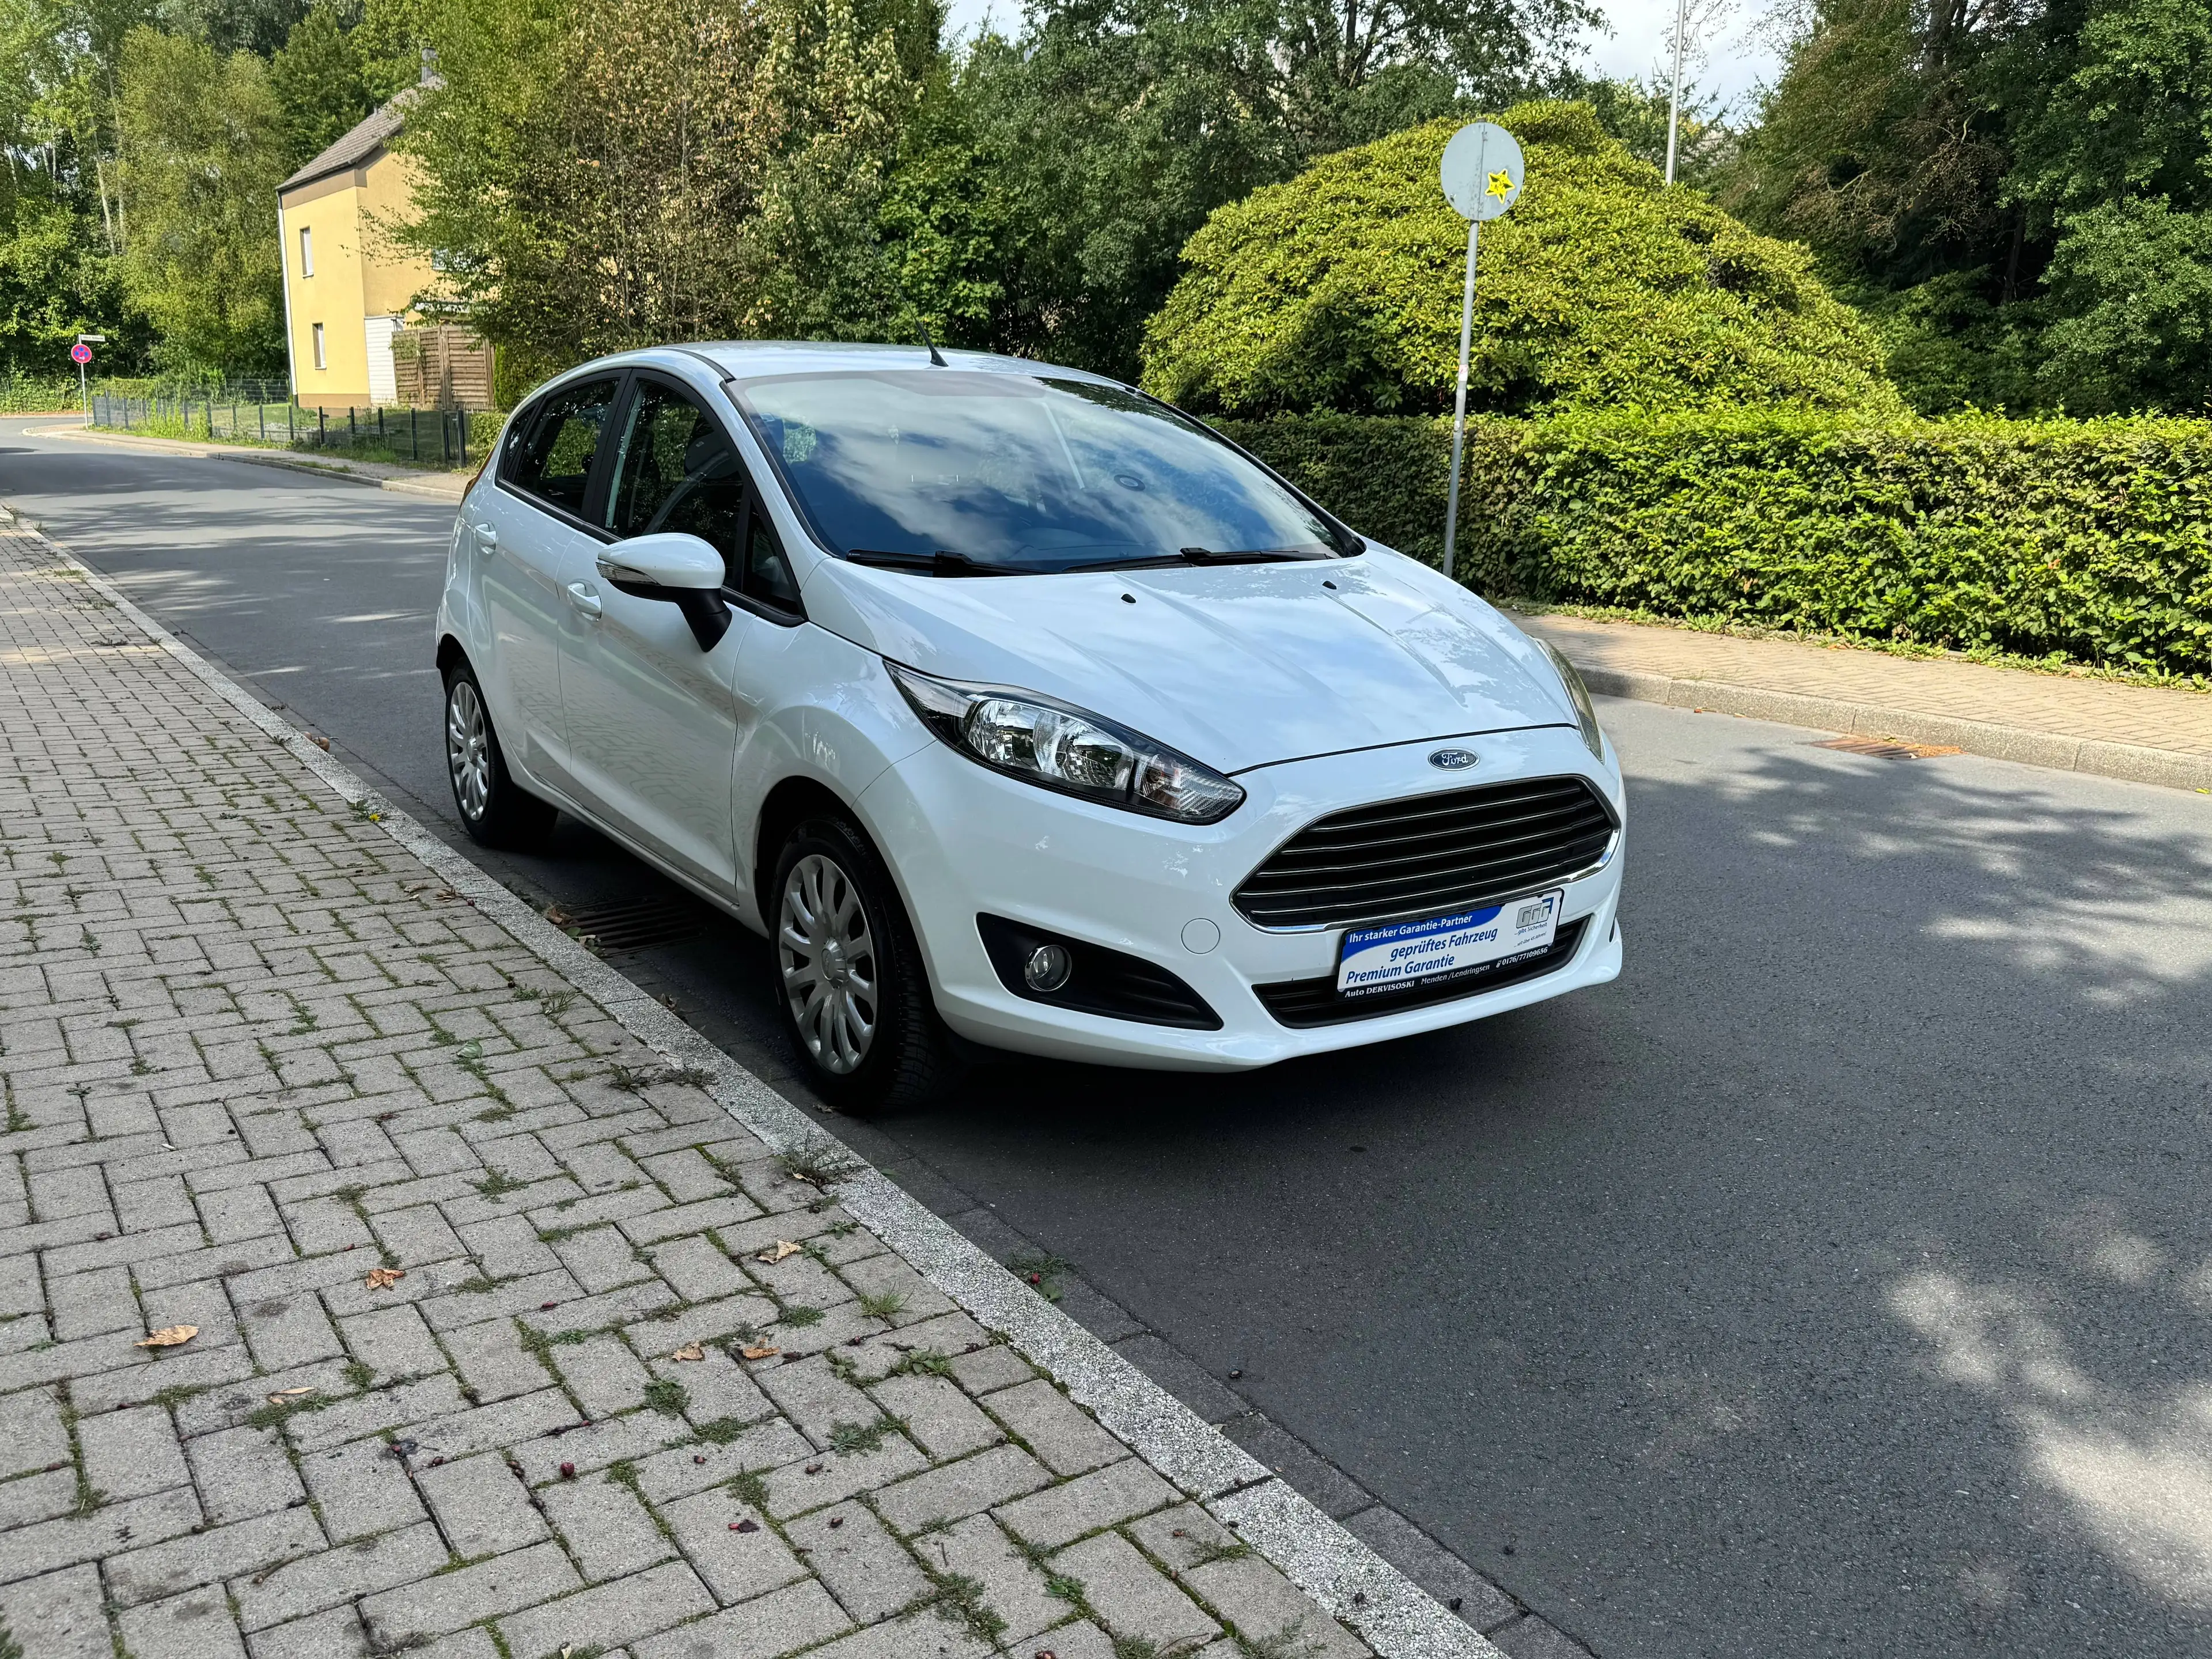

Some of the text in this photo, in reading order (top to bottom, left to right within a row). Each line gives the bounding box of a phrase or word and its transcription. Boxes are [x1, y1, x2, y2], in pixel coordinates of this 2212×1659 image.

[1441, 752, 1469, 766] Ford
[1349, 915, 1473, 943] Ihr starker Garantie-Partner
[1389, 928, 1498, 962] geprüftes Fahrzeug
[1344, 988, 1365, 998] Auto
[1366, 980, 1415, 994] DERVISOSKI
[1421, 974, 1448, 985] Menden
[1502, 946, 1548, 965] 0176/77109656
[1346, 953, 1455, 984] Premium Garantie
